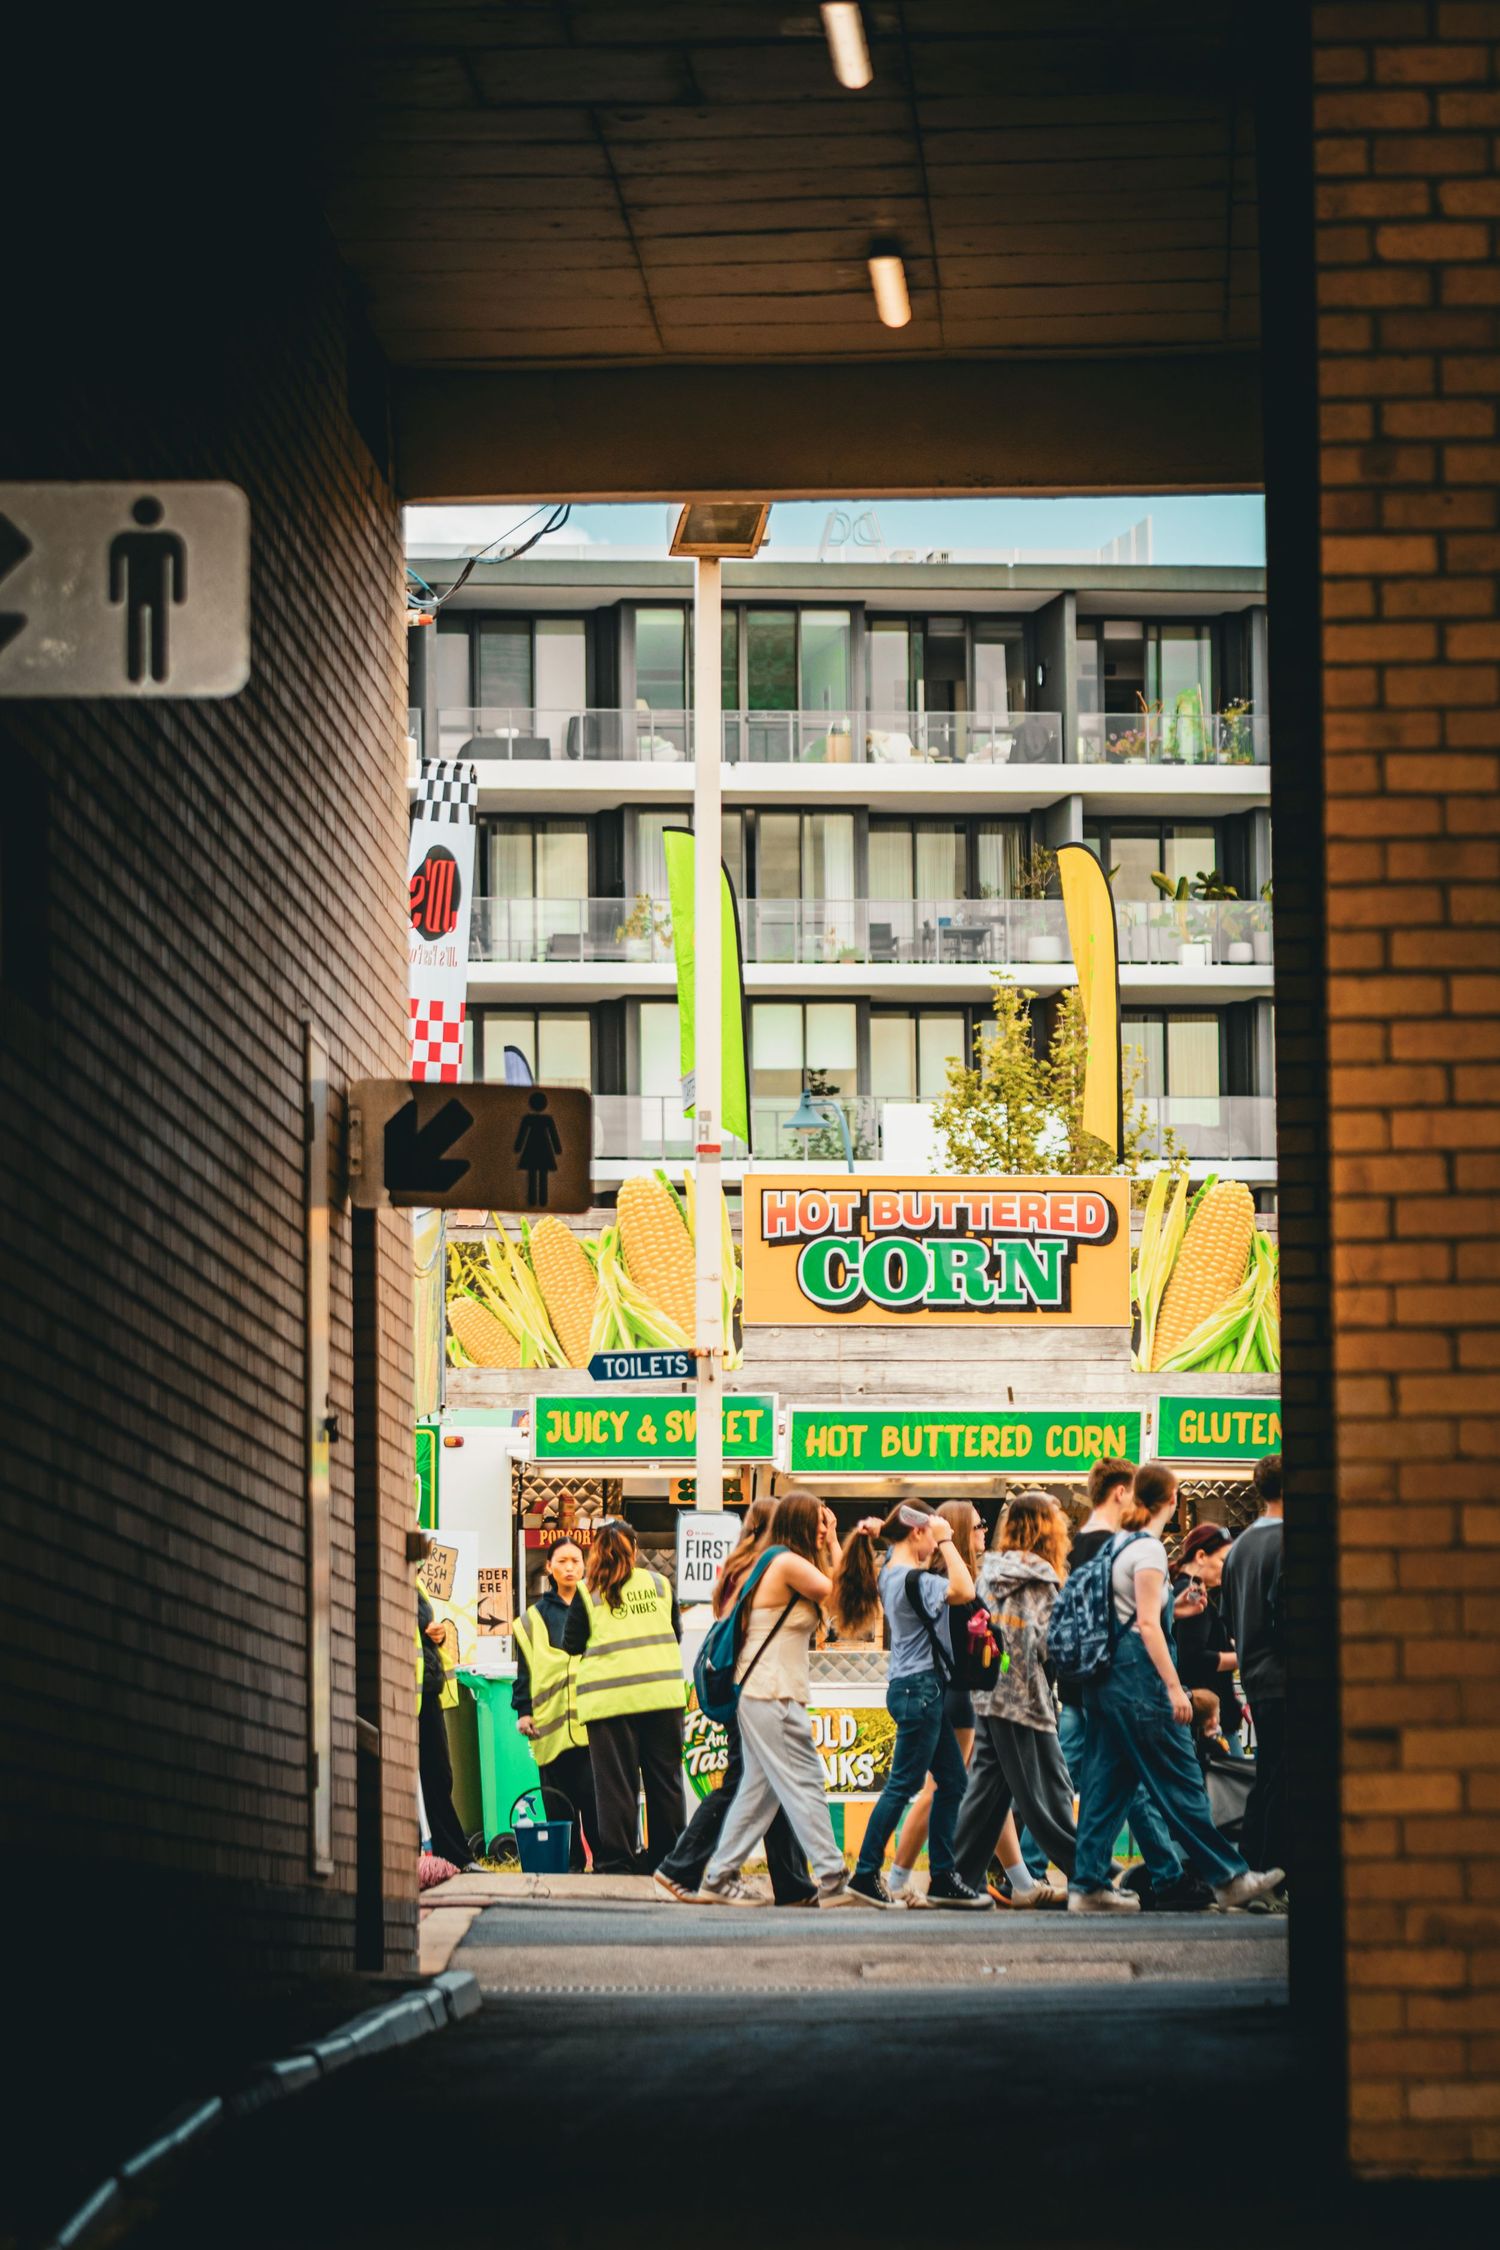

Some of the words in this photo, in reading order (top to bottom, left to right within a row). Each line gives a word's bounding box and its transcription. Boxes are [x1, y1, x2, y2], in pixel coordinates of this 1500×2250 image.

[763, 1190, 860, 1238] HOT
[869, 1191, 1109, 1238] BUTTERED
[800, 1237, 1067, 1306] CORN
[603, 1355, 688, 1378] TOILETS
[546, 1410, 629, 1443] JUICY
[637, 1415, 657, 1445] &
[665, 1410, 763, 1442] SWET
[806, 1425, 867, 1457] HOT
[881, 1425, 1032, 1458] BUTTERED
[1046, 1425, 1126, 1458] CORN
[540, 1529, 596, 1545] POPOR
[430, 1548, 447, 1564] RM
[686, 1540, 733, 1559] FIRST
[423, 1563, 447, 1580] ESH
[478, 1570, 508, 1580] RDER
[685, 1563, 712, 1581] AID
[424, 1578, 441, 1594] RN
[480, 1583, 501, 1593] ERE
[627, 1589, 656, 1601] CLEAN
[629, 1602, 657, 1614] VIBES
[809, 1714, 857, 1748] OLD
[686, 1745, 728, 1776] Tas
